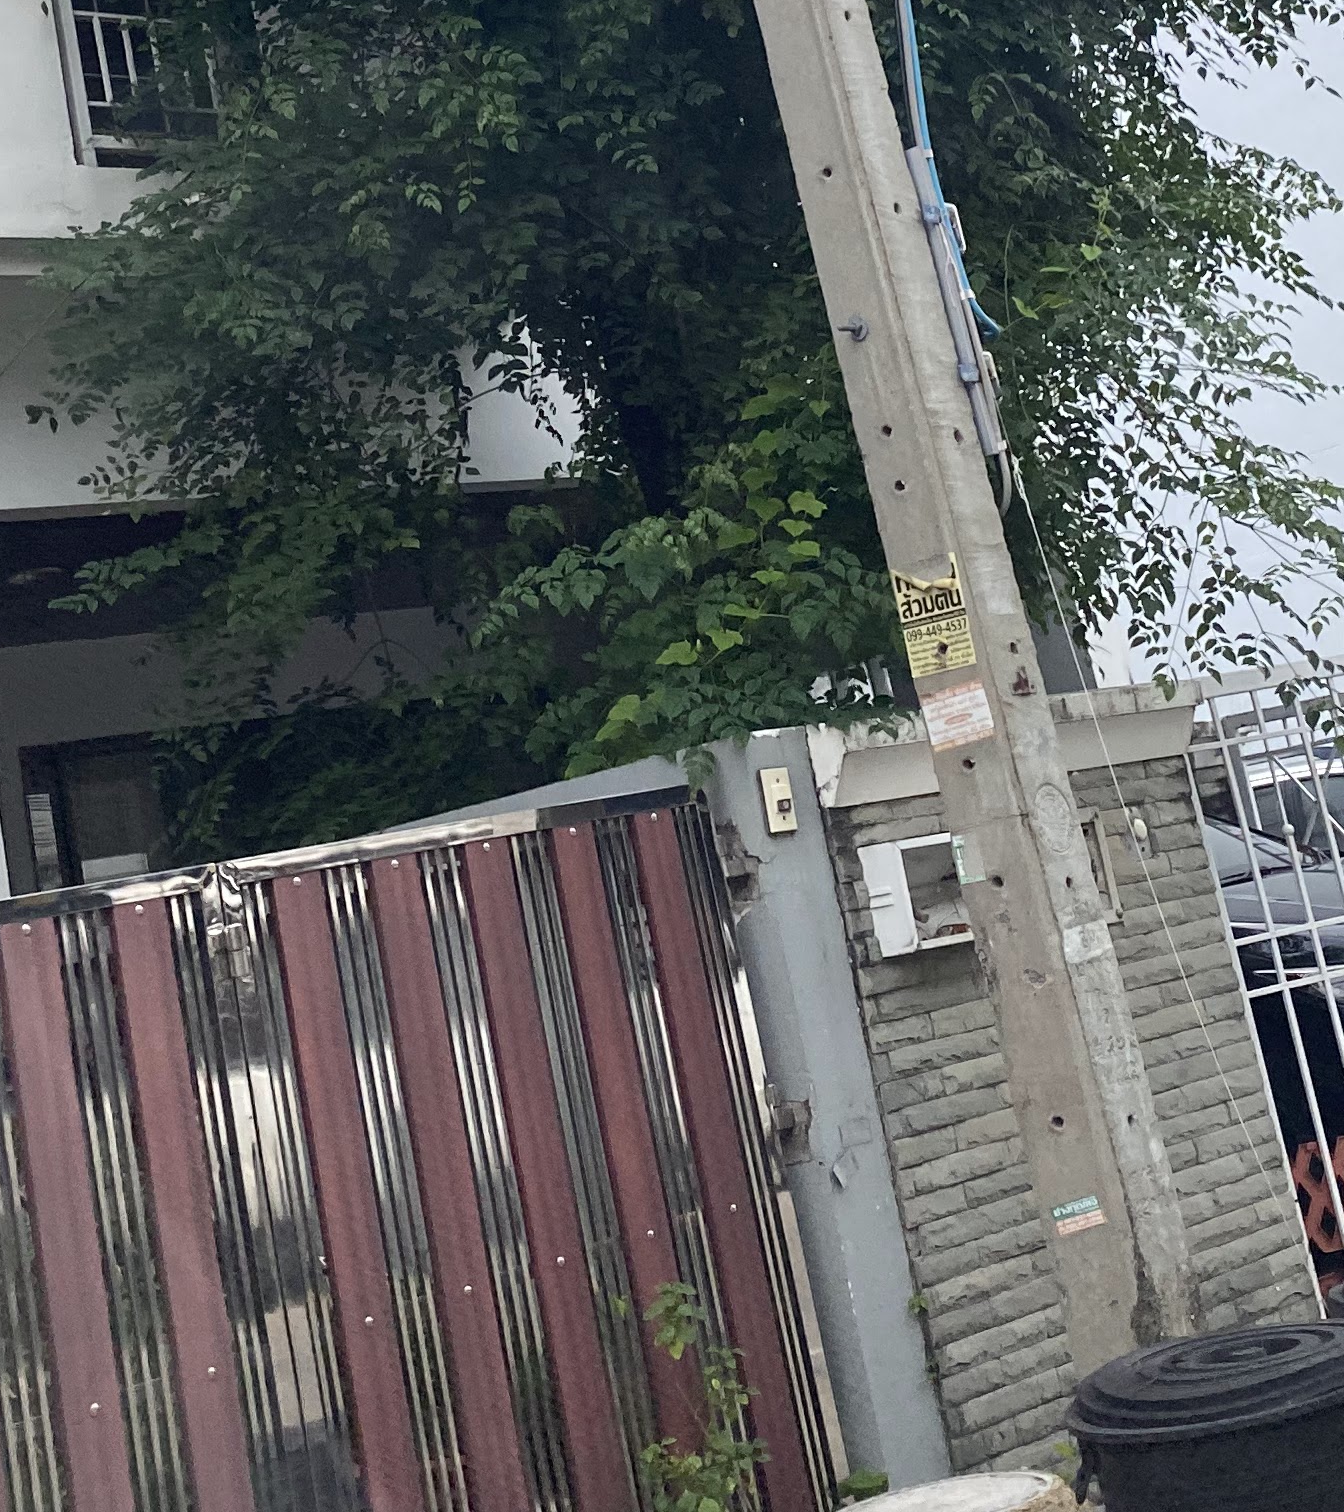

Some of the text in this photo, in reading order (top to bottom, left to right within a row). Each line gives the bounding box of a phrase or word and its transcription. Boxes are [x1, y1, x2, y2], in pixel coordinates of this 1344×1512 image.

[900, 588, 963, 620] ส้วมตน
[906, 617, 968, 643] 099-449-4537
